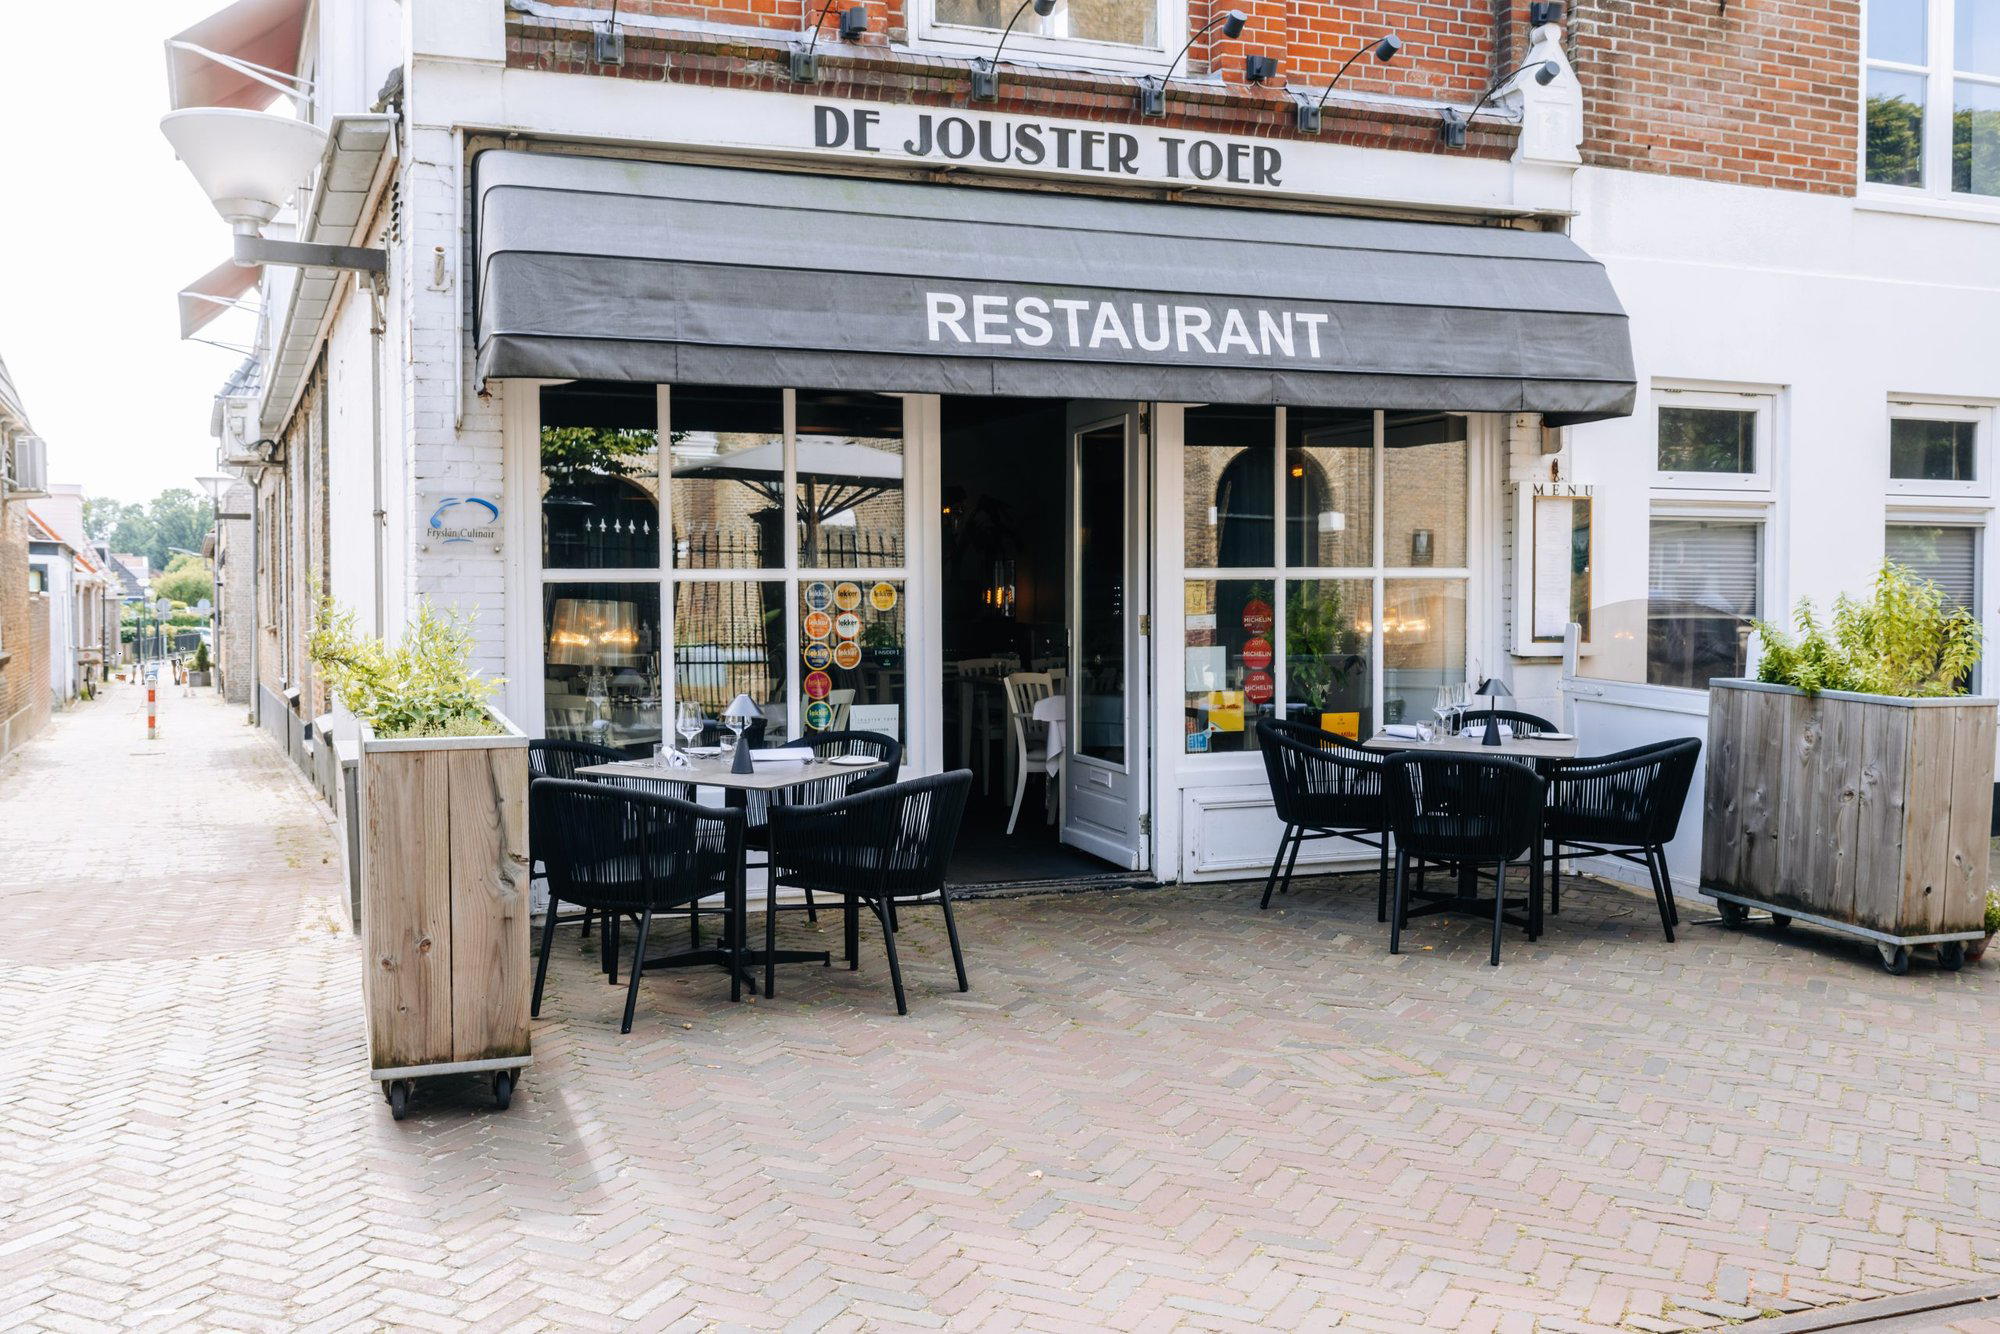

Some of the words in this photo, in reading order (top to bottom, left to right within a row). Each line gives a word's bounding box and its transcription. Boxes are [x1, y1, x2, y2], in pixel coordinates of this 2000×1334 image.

[813, 105, 881, 152] DE
[903, 114, 1140, 175] JOUSTER
[1159, 137, 1283, 186] TOER
[926, 292, 1329, 358] RESTAURANT
[1533, 484, 1594, 496] MENU
[460, 528, 495, 538] Culinair
[838, 619, 857, 627] lekker
[1245, 684, 1273, 692] MICHELIN
